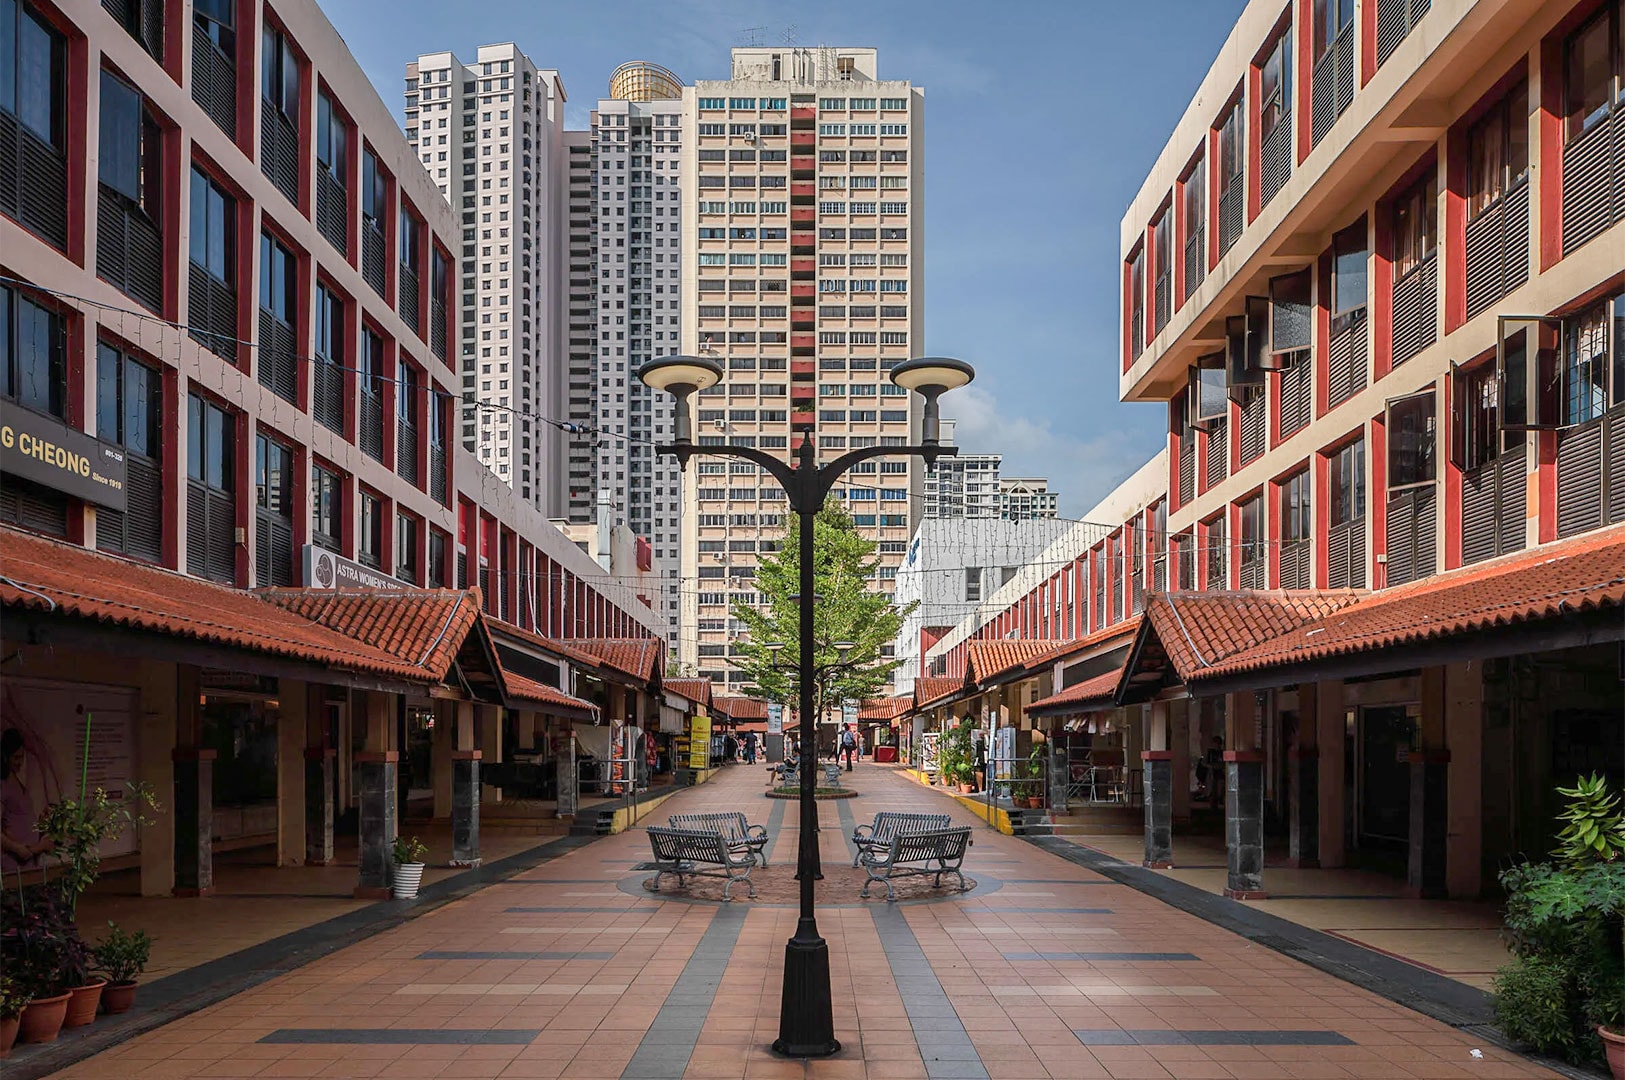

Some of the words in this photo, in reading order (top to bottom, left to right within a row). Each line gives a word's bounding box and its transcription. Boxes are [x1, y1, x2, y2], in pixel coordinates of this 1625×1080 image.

[1, 426, 14, 448] G
[19, 433, 90, 477] CHEONG
[92, 472, 108, 485] Since
[337, 564, 359, 581] ASTRA
